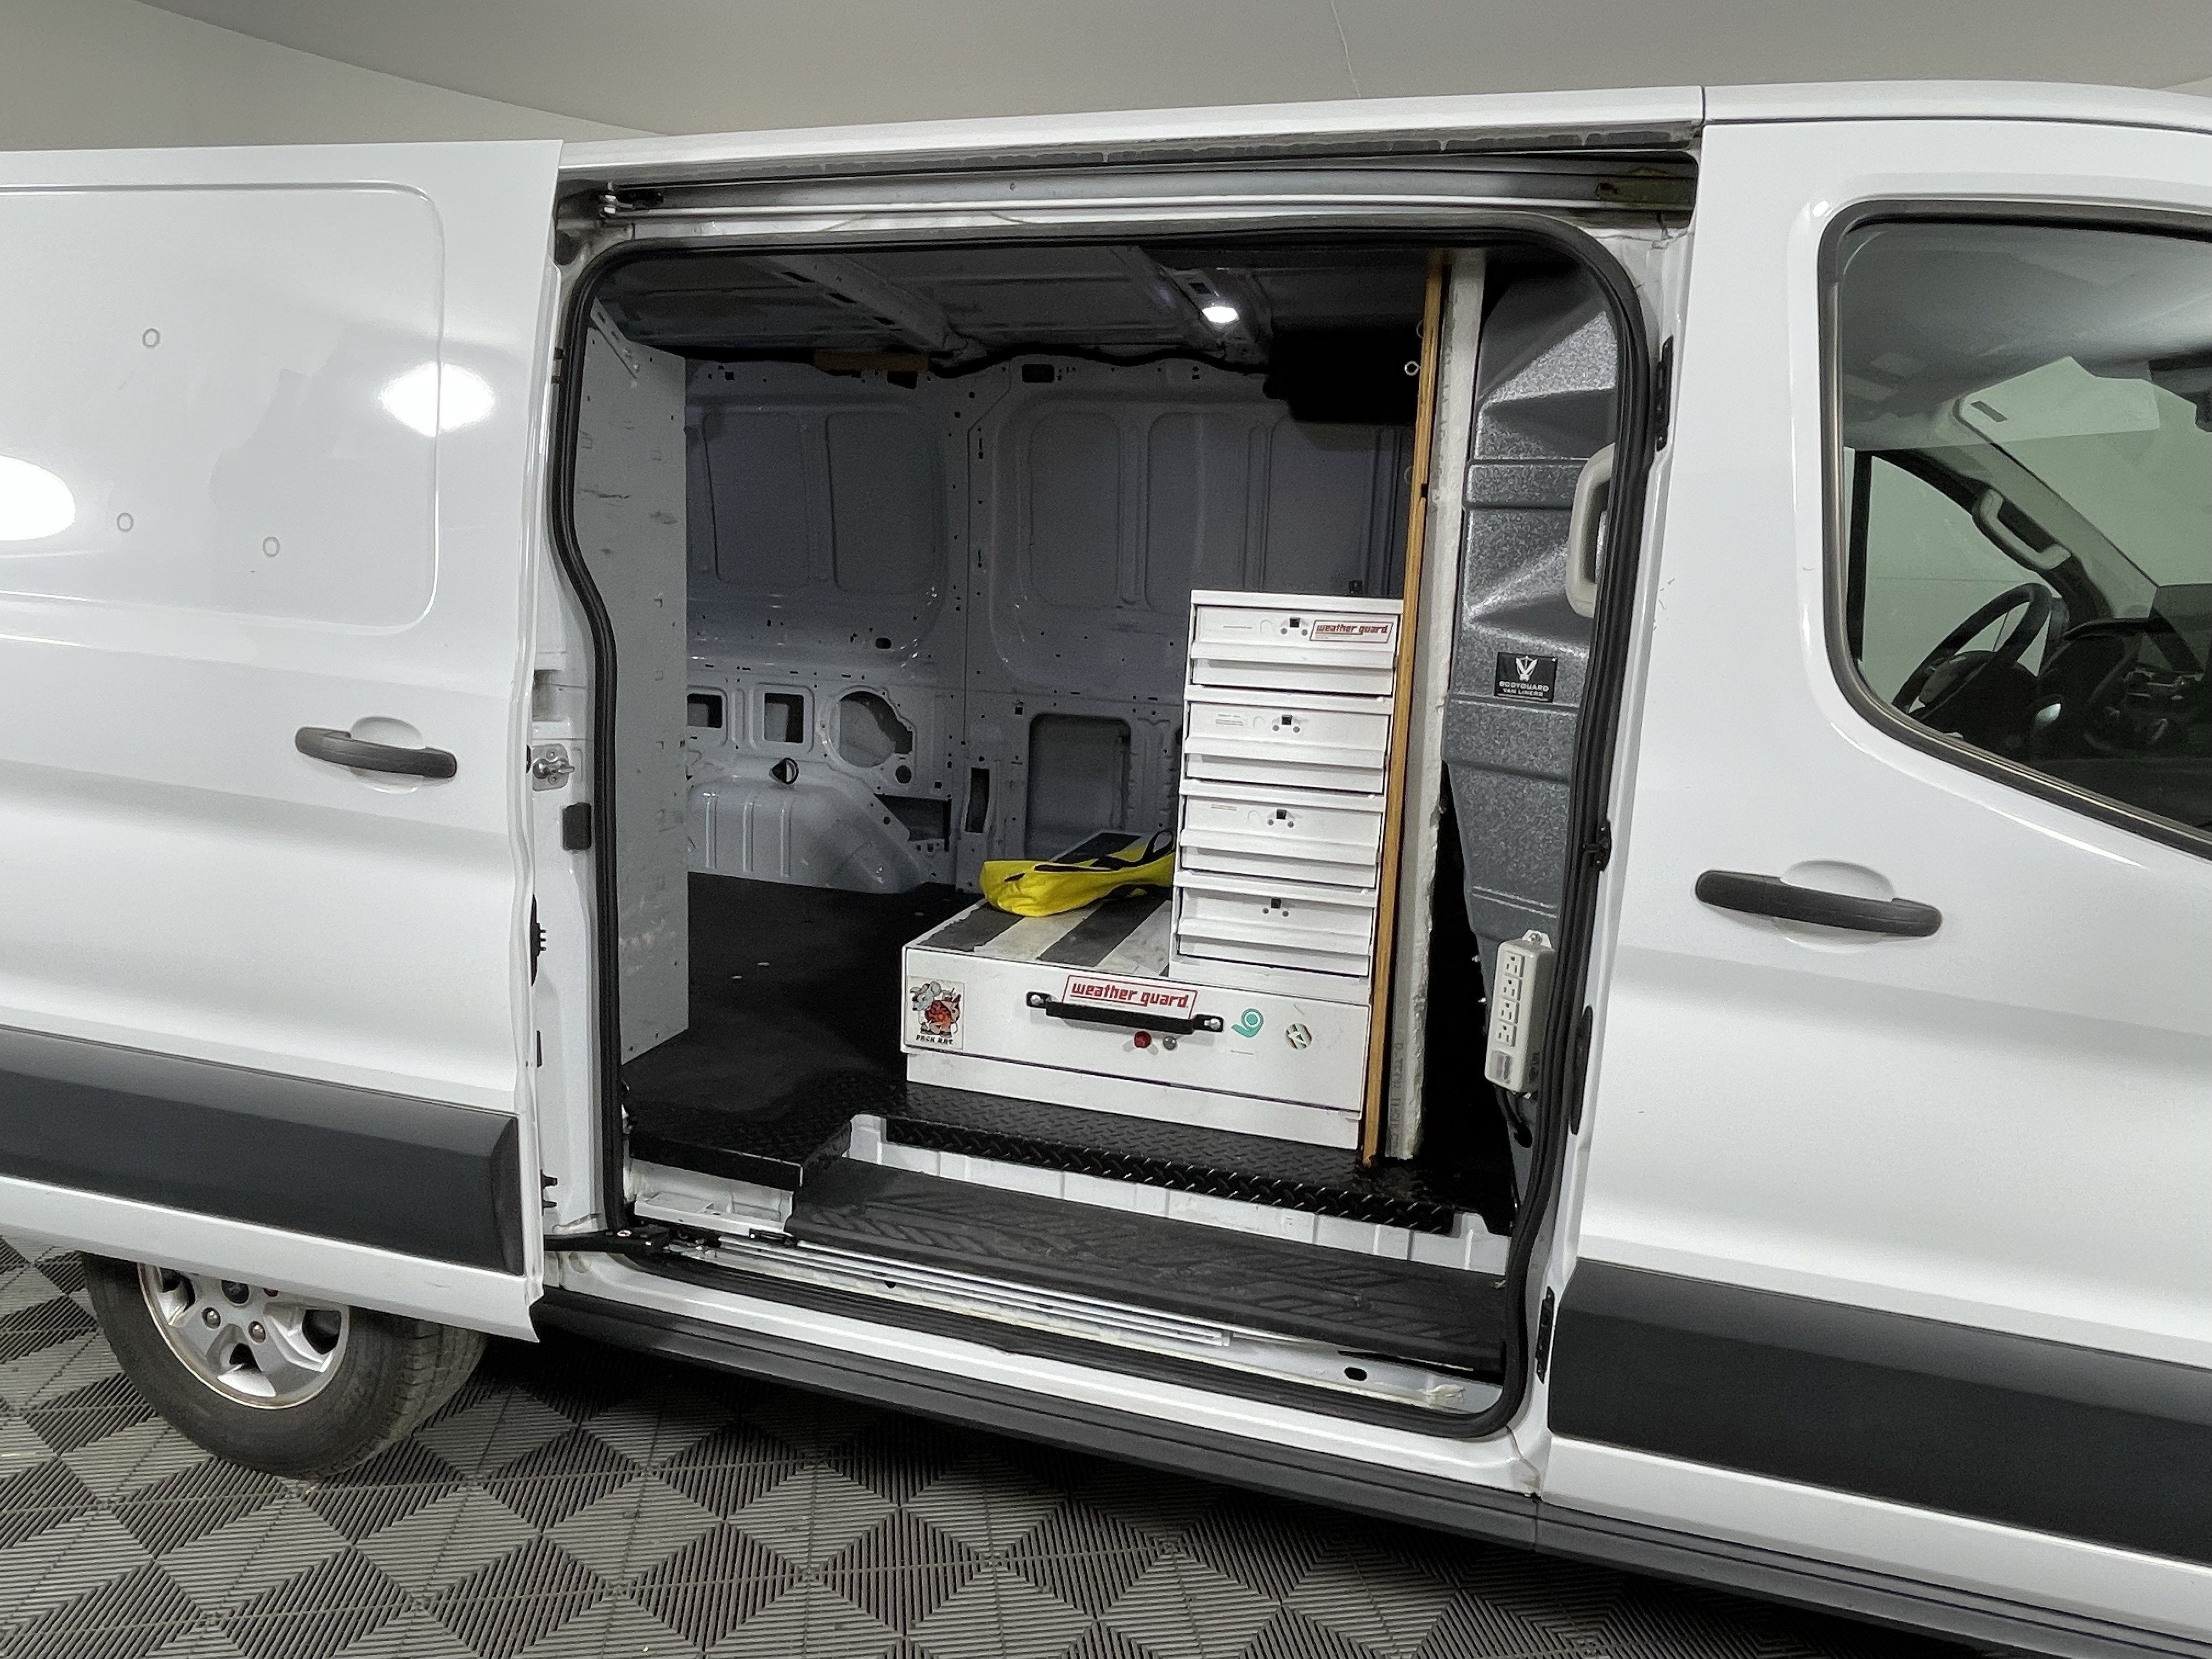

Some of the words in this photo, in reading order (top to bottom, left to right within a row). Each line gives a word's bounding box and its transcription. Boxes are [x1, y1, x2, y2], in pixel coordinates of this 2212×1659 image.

[1317, 623, 1357, 633] weather
[1359, 624, 1388, 635] guard
[1071, 982, 1138, 1001] weather
[1141, 991, 1189, 1008] guard
